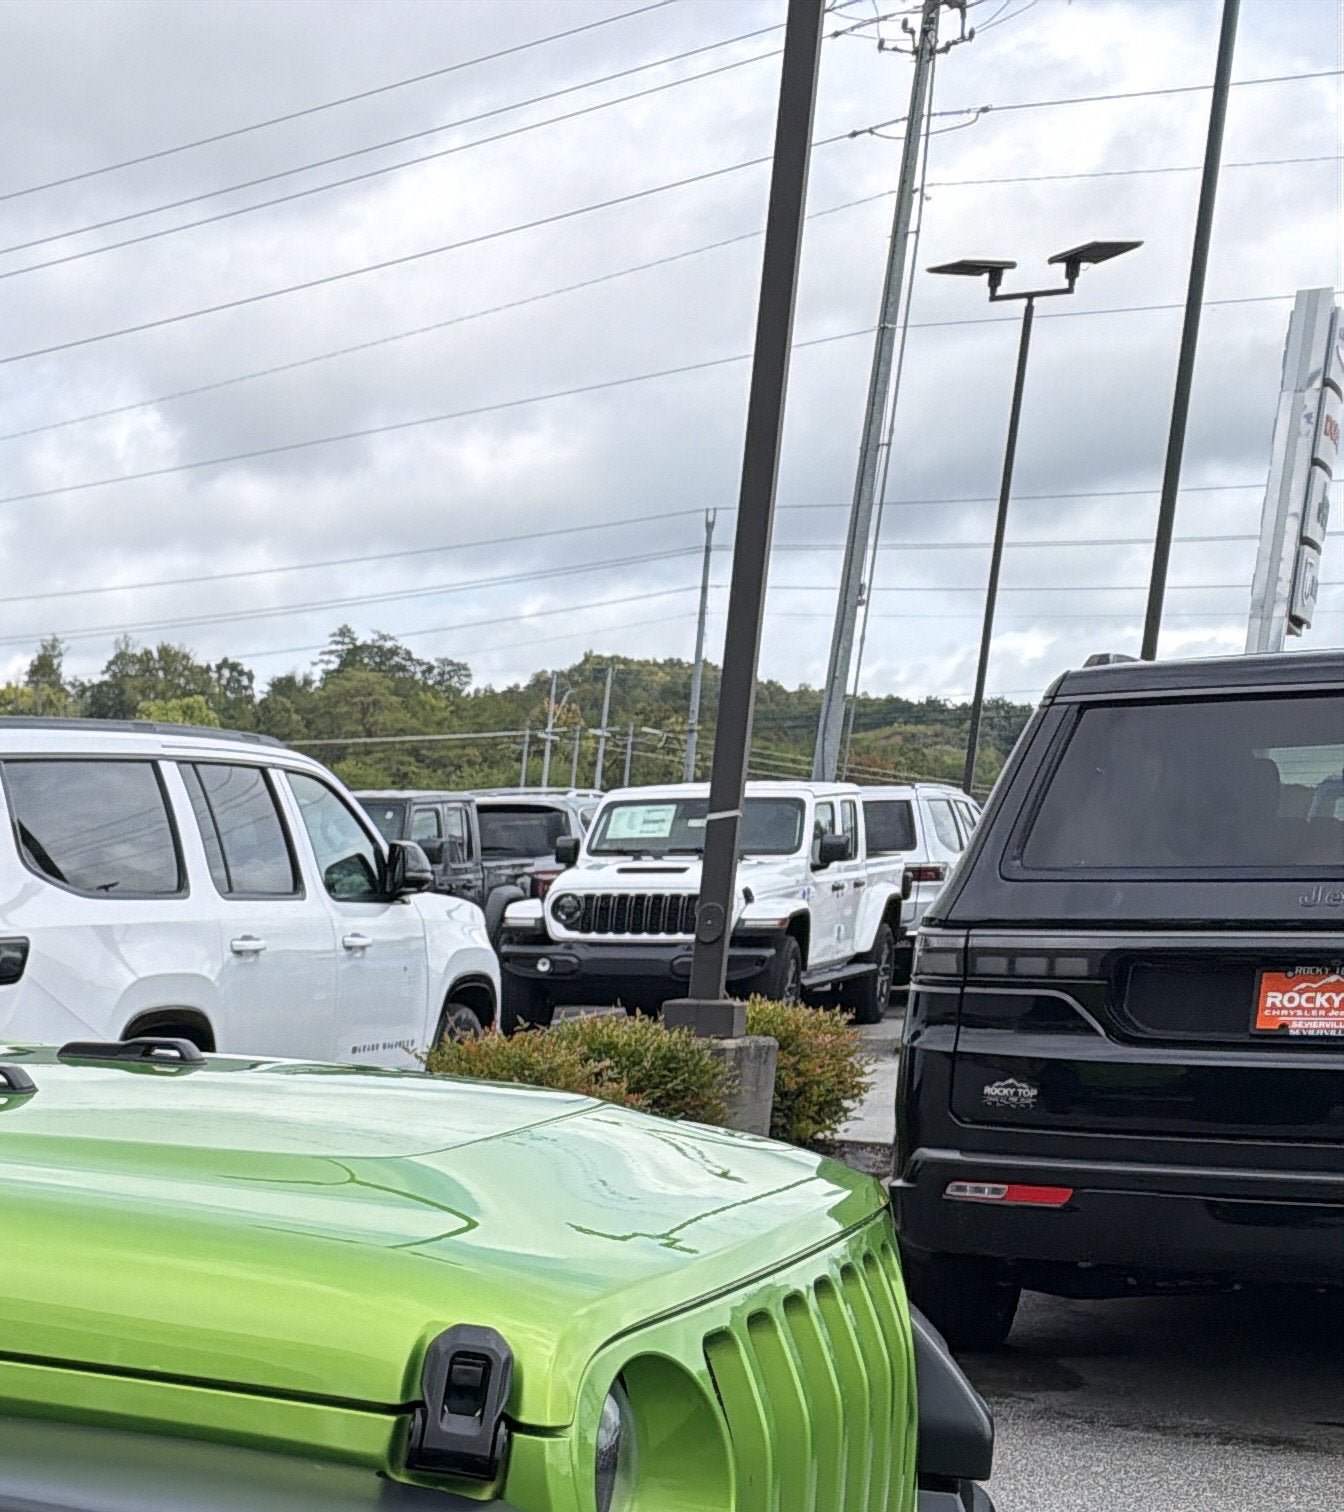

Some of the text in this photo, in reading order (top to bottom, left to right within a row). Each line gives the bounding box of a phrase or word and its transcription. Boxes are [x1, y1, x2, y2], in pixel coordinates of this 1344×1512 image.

[1298, 885, 1344, 908] Je
[1265, 992, 1344, 1008] ROCKY
[1263, 1009, 1326, 1017] CHRYSLER
